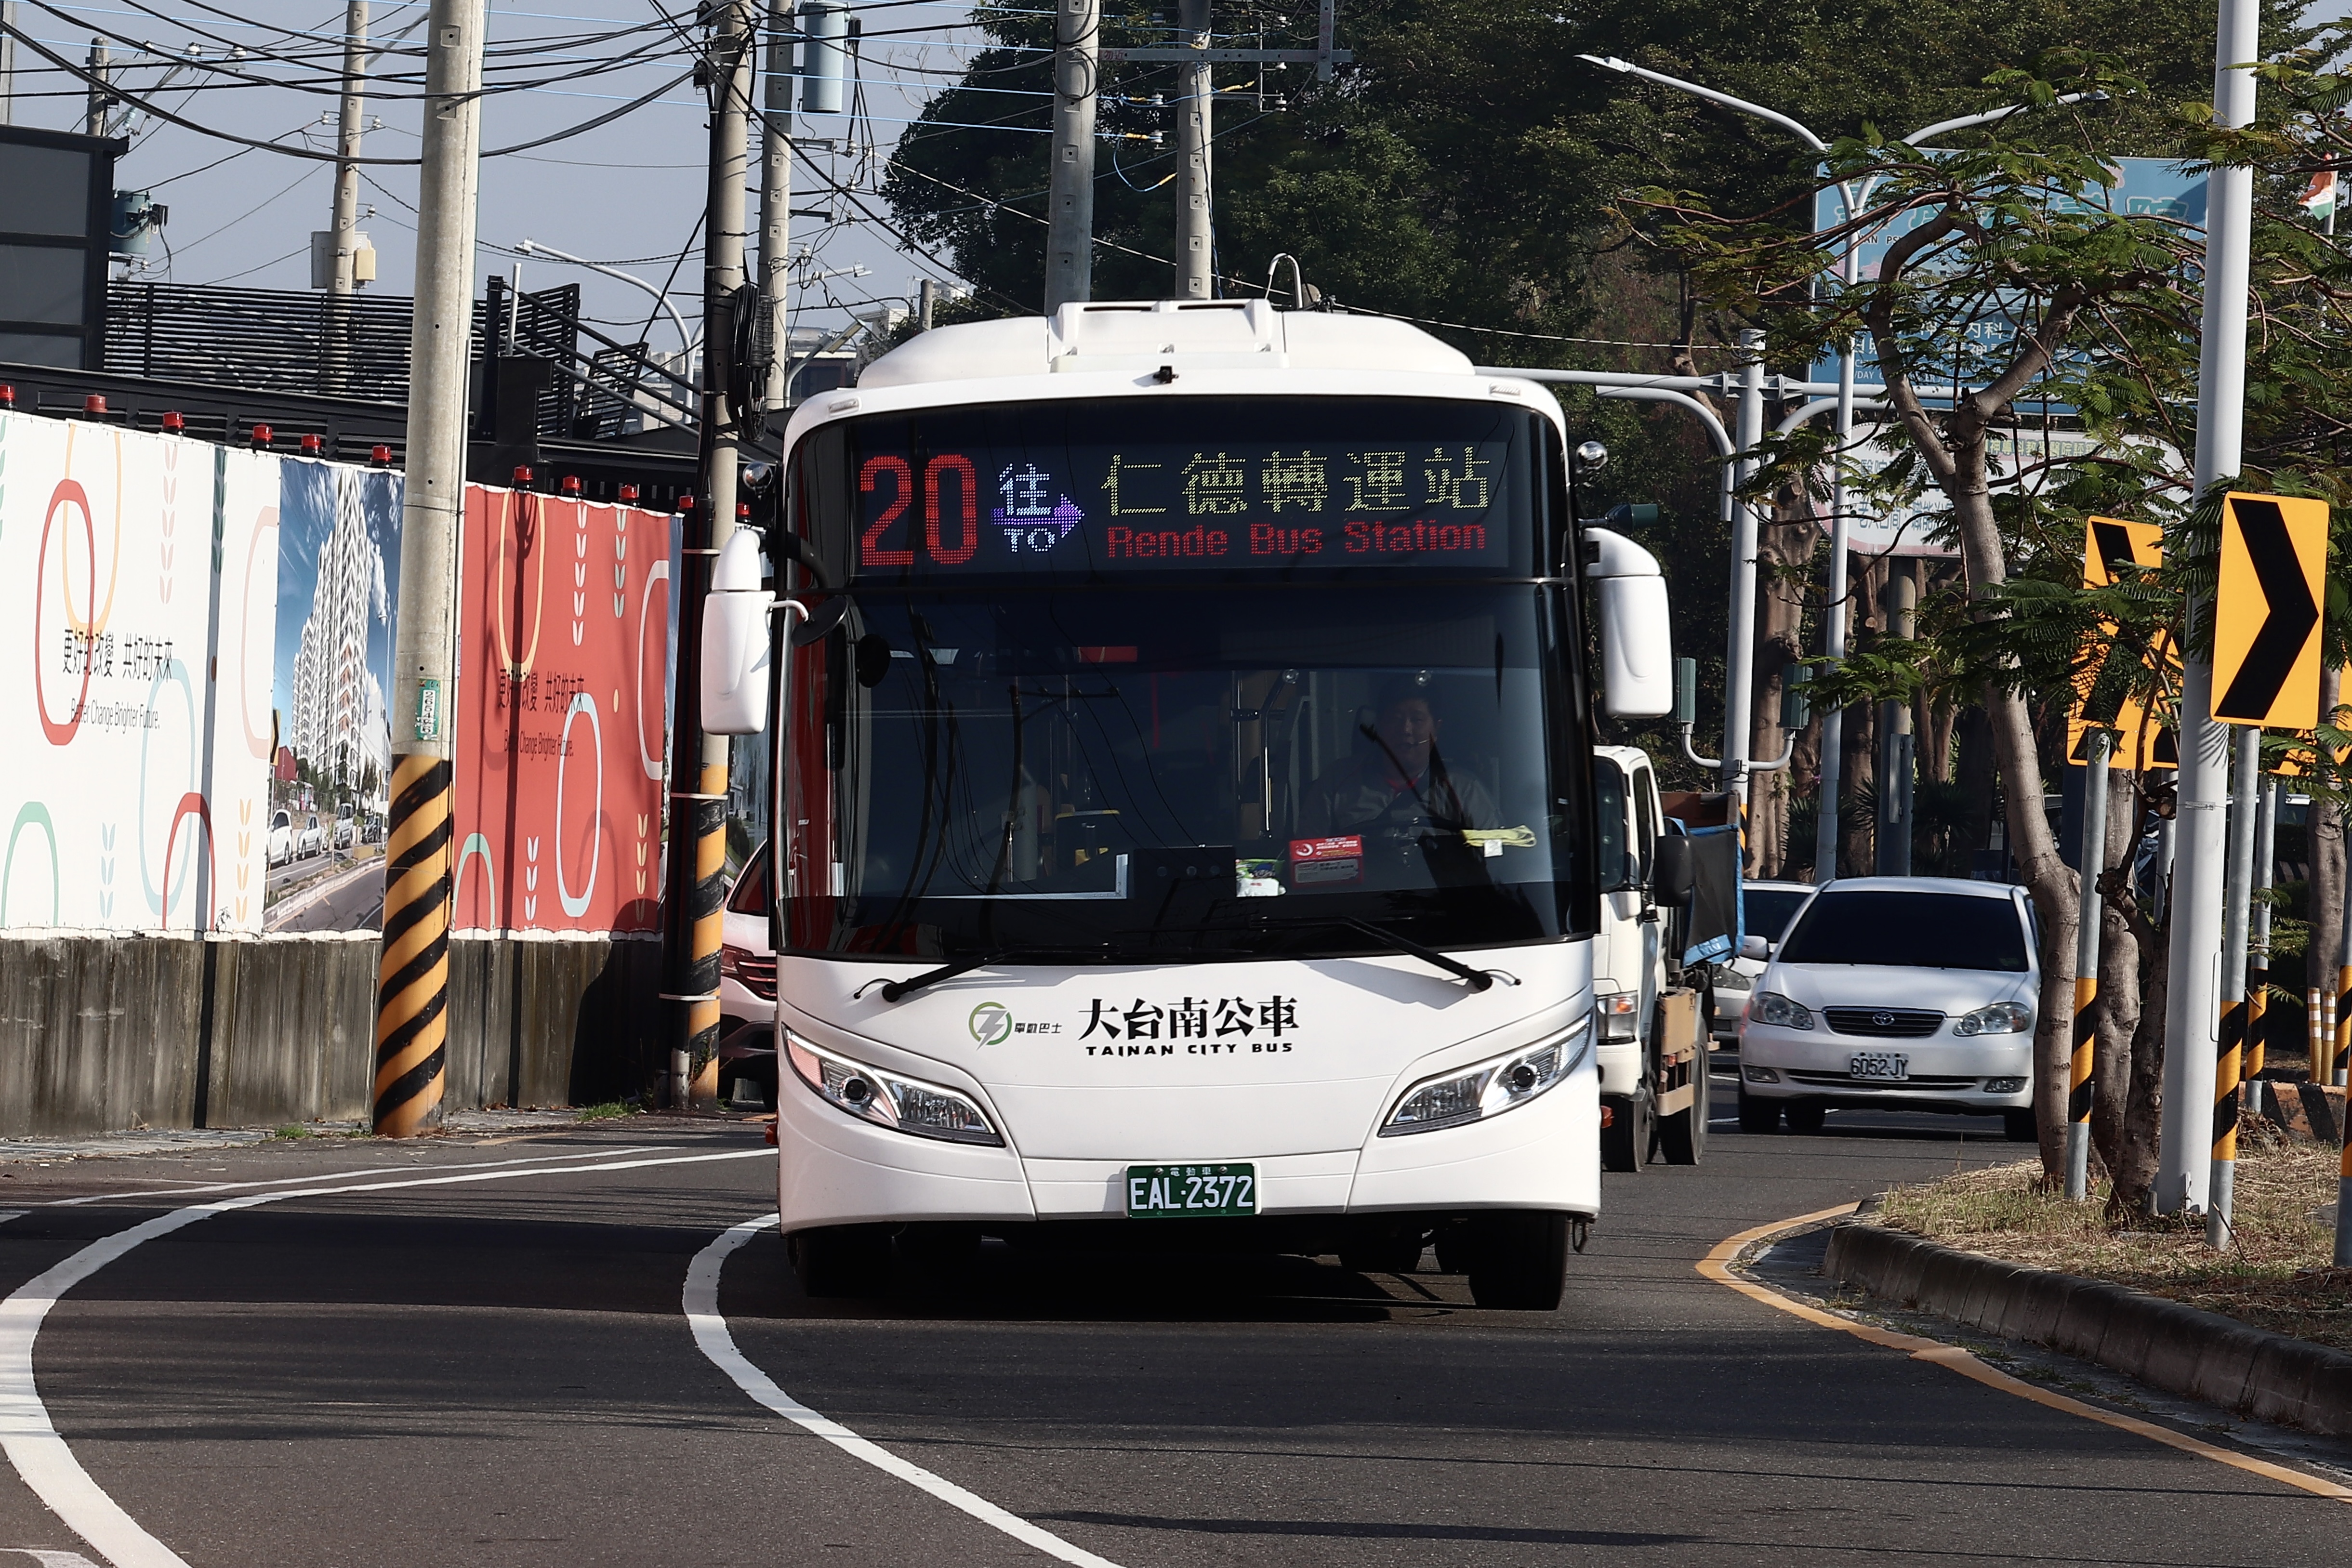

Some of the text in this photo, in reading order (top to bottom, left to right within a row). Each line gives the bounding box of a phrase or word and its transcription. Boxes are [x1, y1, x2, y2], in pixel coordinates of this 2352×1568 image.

[999, 462, 1052, 515] 往
[1100, 446, 1490, 516] 仁德轉運站
[860, 454, 978, 566] 20
[1004, 528, 1056, 553] TO
[1107, 520, 1486, 557] Rende Bus Station
[63, 627, 173, 683] 更好的改變 共好的未來
[544, 671, 584, 715] 共好的未來
[71, 698, 160, 735] Better Change Brighter Future.
[519, 730, 538, 761] Change
[538, 732, 557, 762] Brighter
[1077, 995, 1300, 1041] 大台南公車
[1085, 1042, 1293, 1057] TAINAN CITY BUS
[1851, 1057, 1909, 1077] 6052-JY
[1169, 1166, 1212, 1177] 電動車
[1130, 1175, 1254, 1210] EAL-2372
